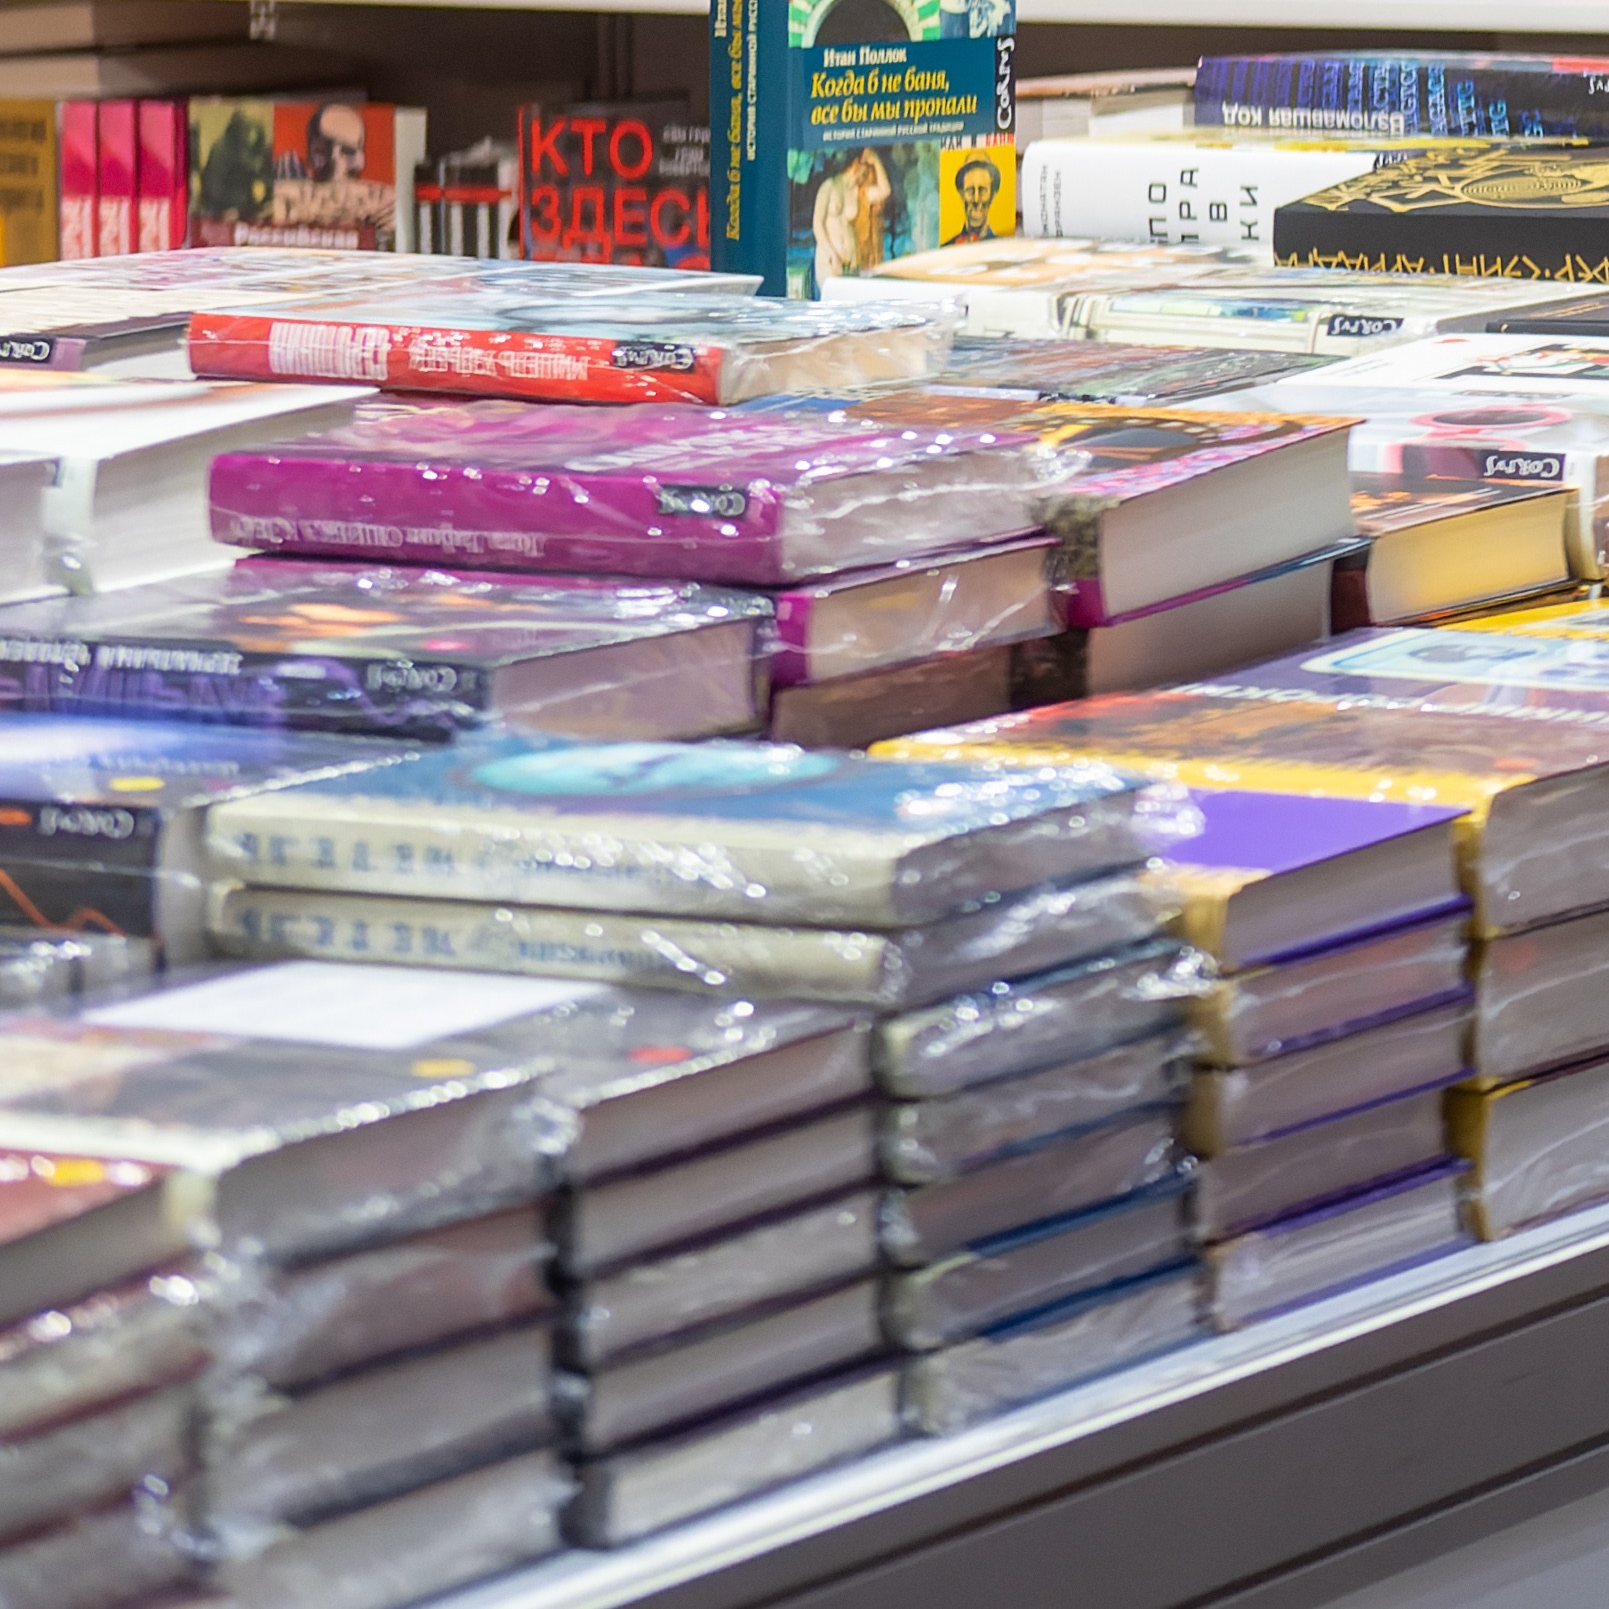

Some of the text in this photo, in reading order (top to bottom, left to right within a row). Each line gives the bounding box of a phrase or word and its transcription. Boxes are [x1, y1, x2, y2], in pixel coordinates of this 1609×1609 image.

[823, 45, 908, 68] Итан Поллок
[810, 64, 950, 99] Когда б не баня,
[810, 94, 978, 126] все бы мы пропали
[1221, 100, 1405, 134] Взломавшая код
[530, 118, 654, 179] КТО
